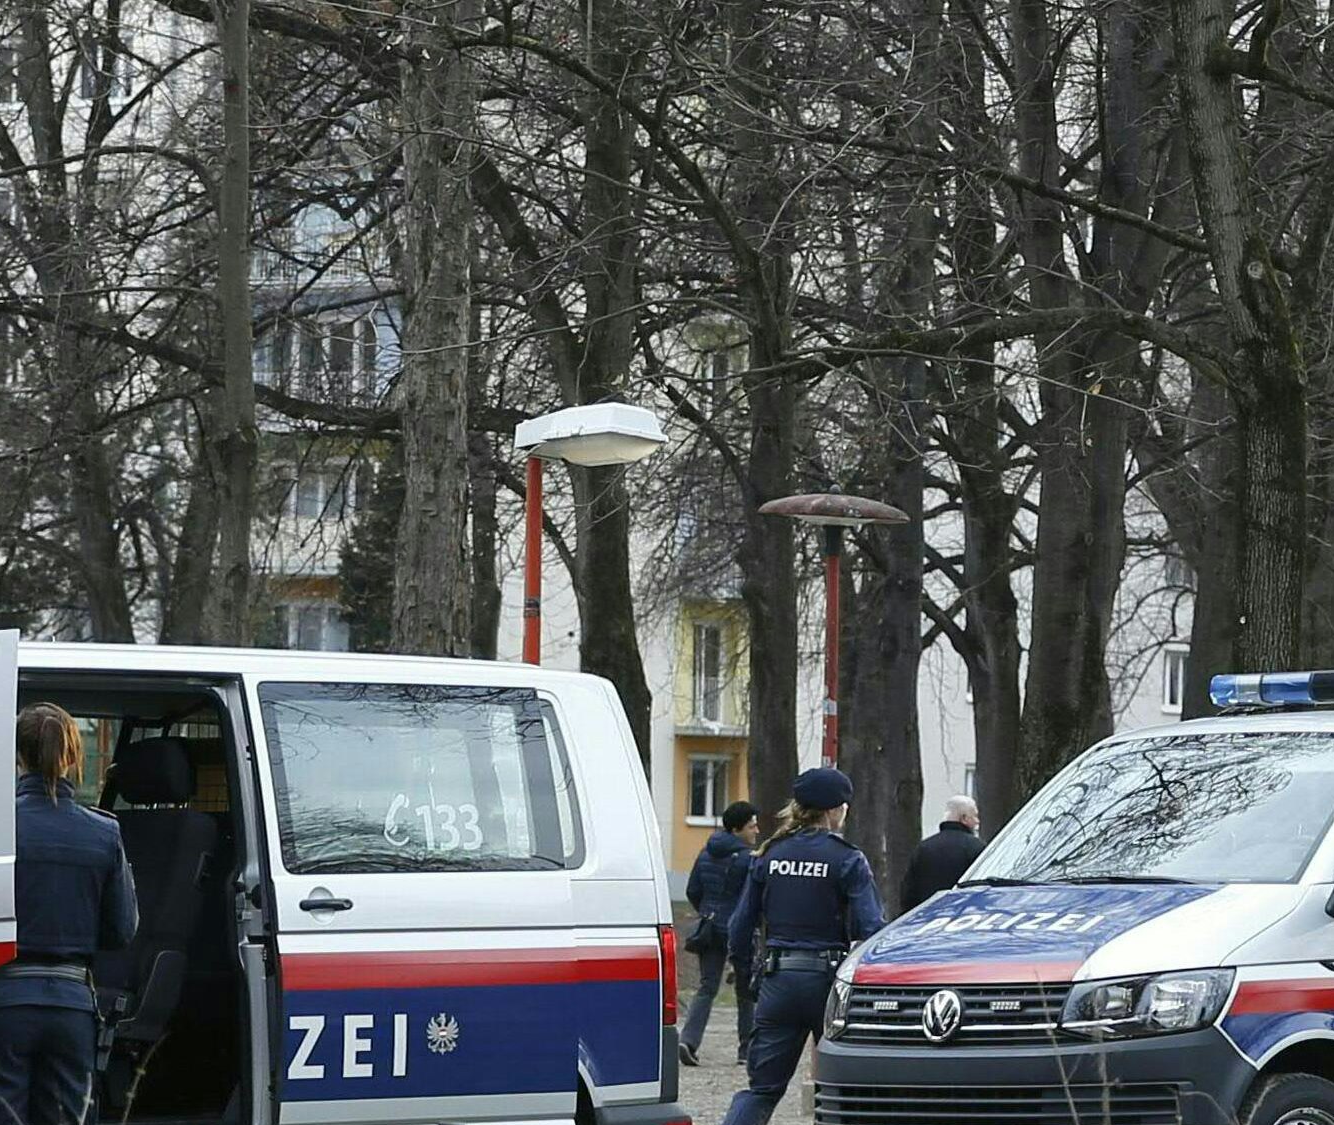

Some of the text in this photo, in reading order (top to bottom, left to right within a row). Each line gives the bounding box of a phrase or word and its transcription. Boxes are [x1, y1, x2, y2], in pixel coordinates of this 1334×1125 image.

[415, 803, 484, 851] 133
[769, 860, 829, 877] POLIZEI
[915, 912, 1105, 935] POLIZEI
[287, 1013, 408, 1080] ZEI
